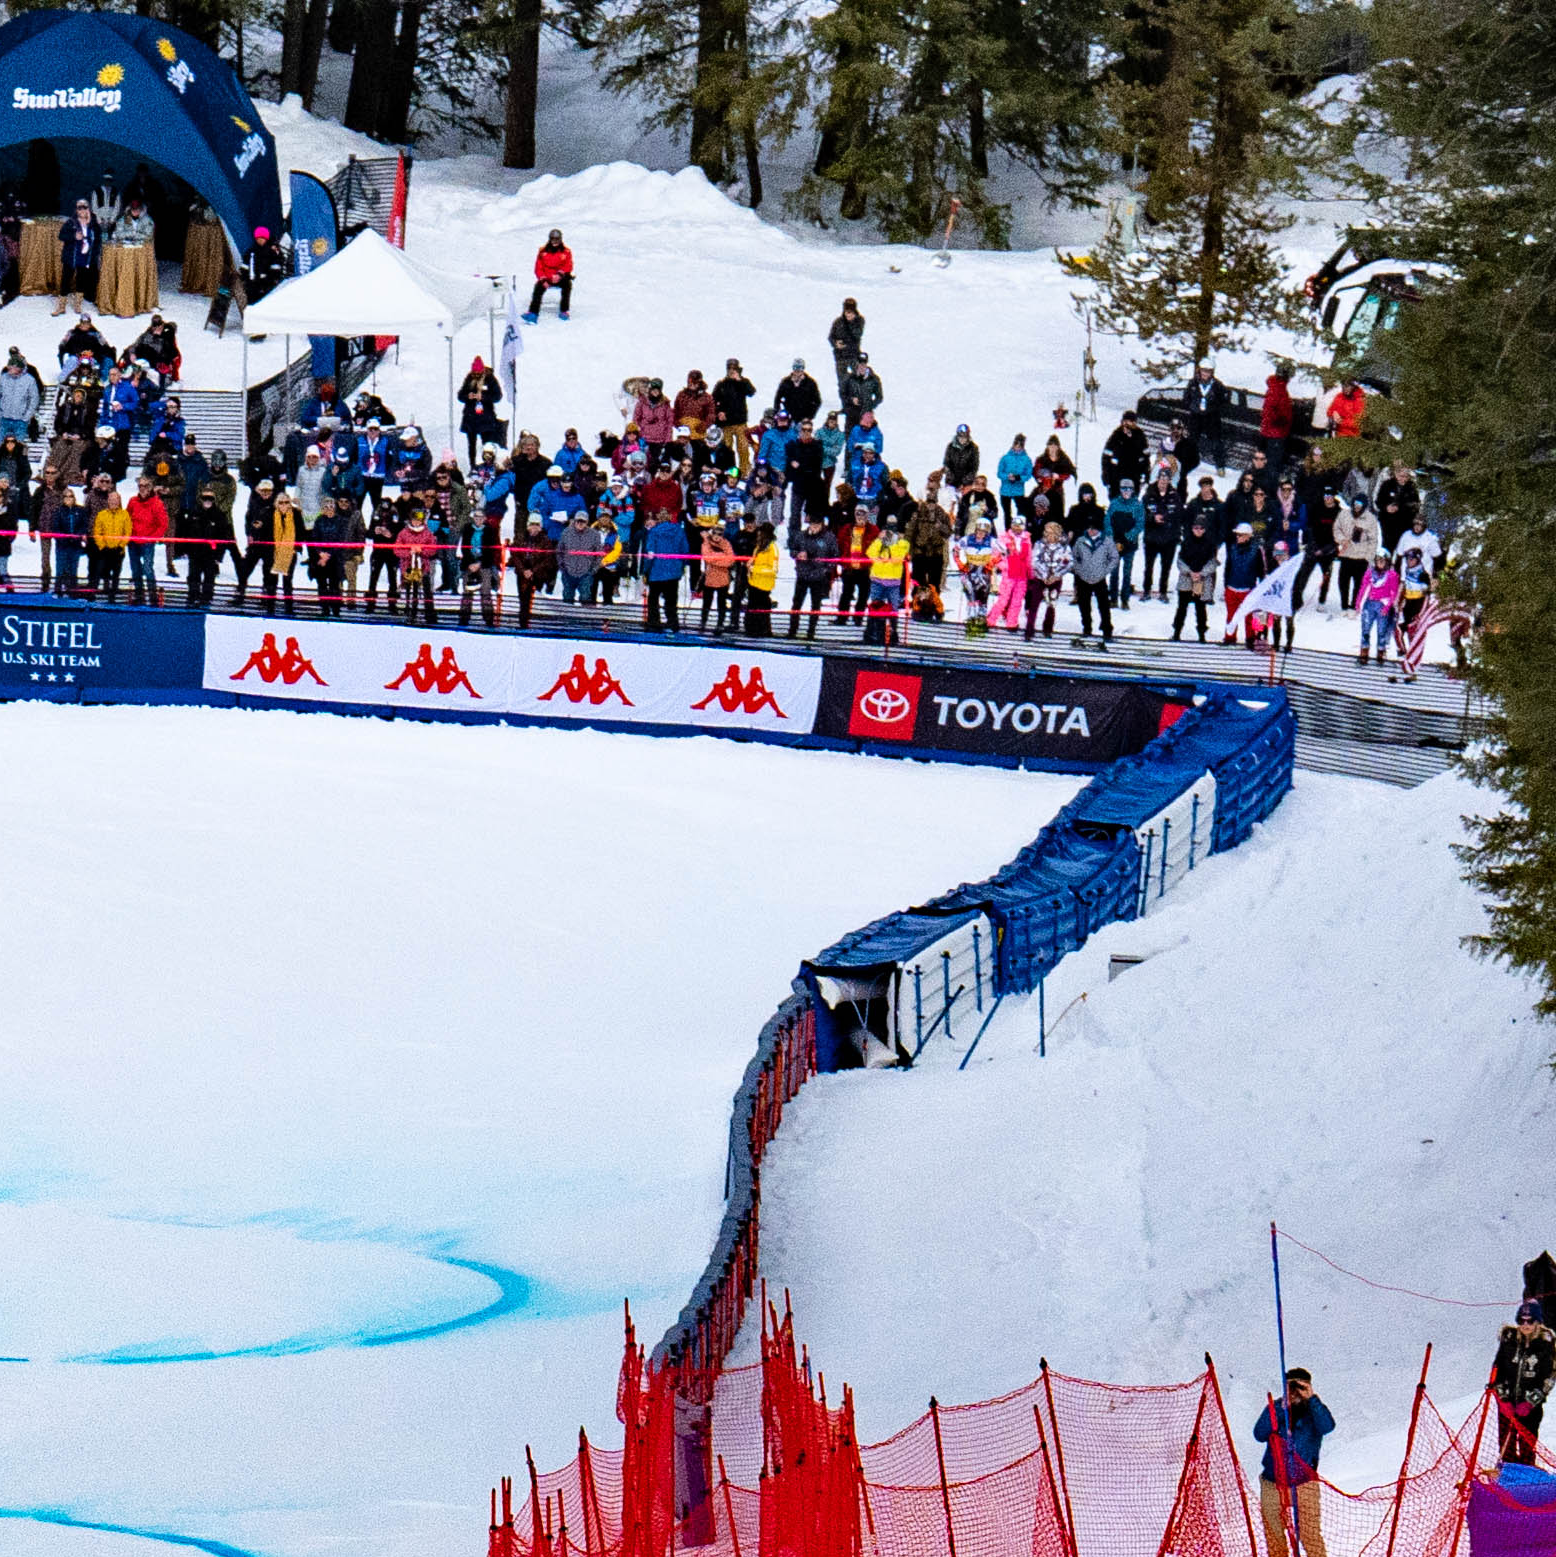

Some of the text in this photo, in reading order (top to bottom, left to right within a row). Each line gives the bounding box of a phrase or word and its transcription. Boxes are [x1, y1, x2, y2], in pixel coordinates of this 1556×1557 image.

[1, 615, 102, 649] STIFEL
[1, 652, 101, 668] U.S. SKI TEAM
[933, 695, 1091, 737] TOYOTA
